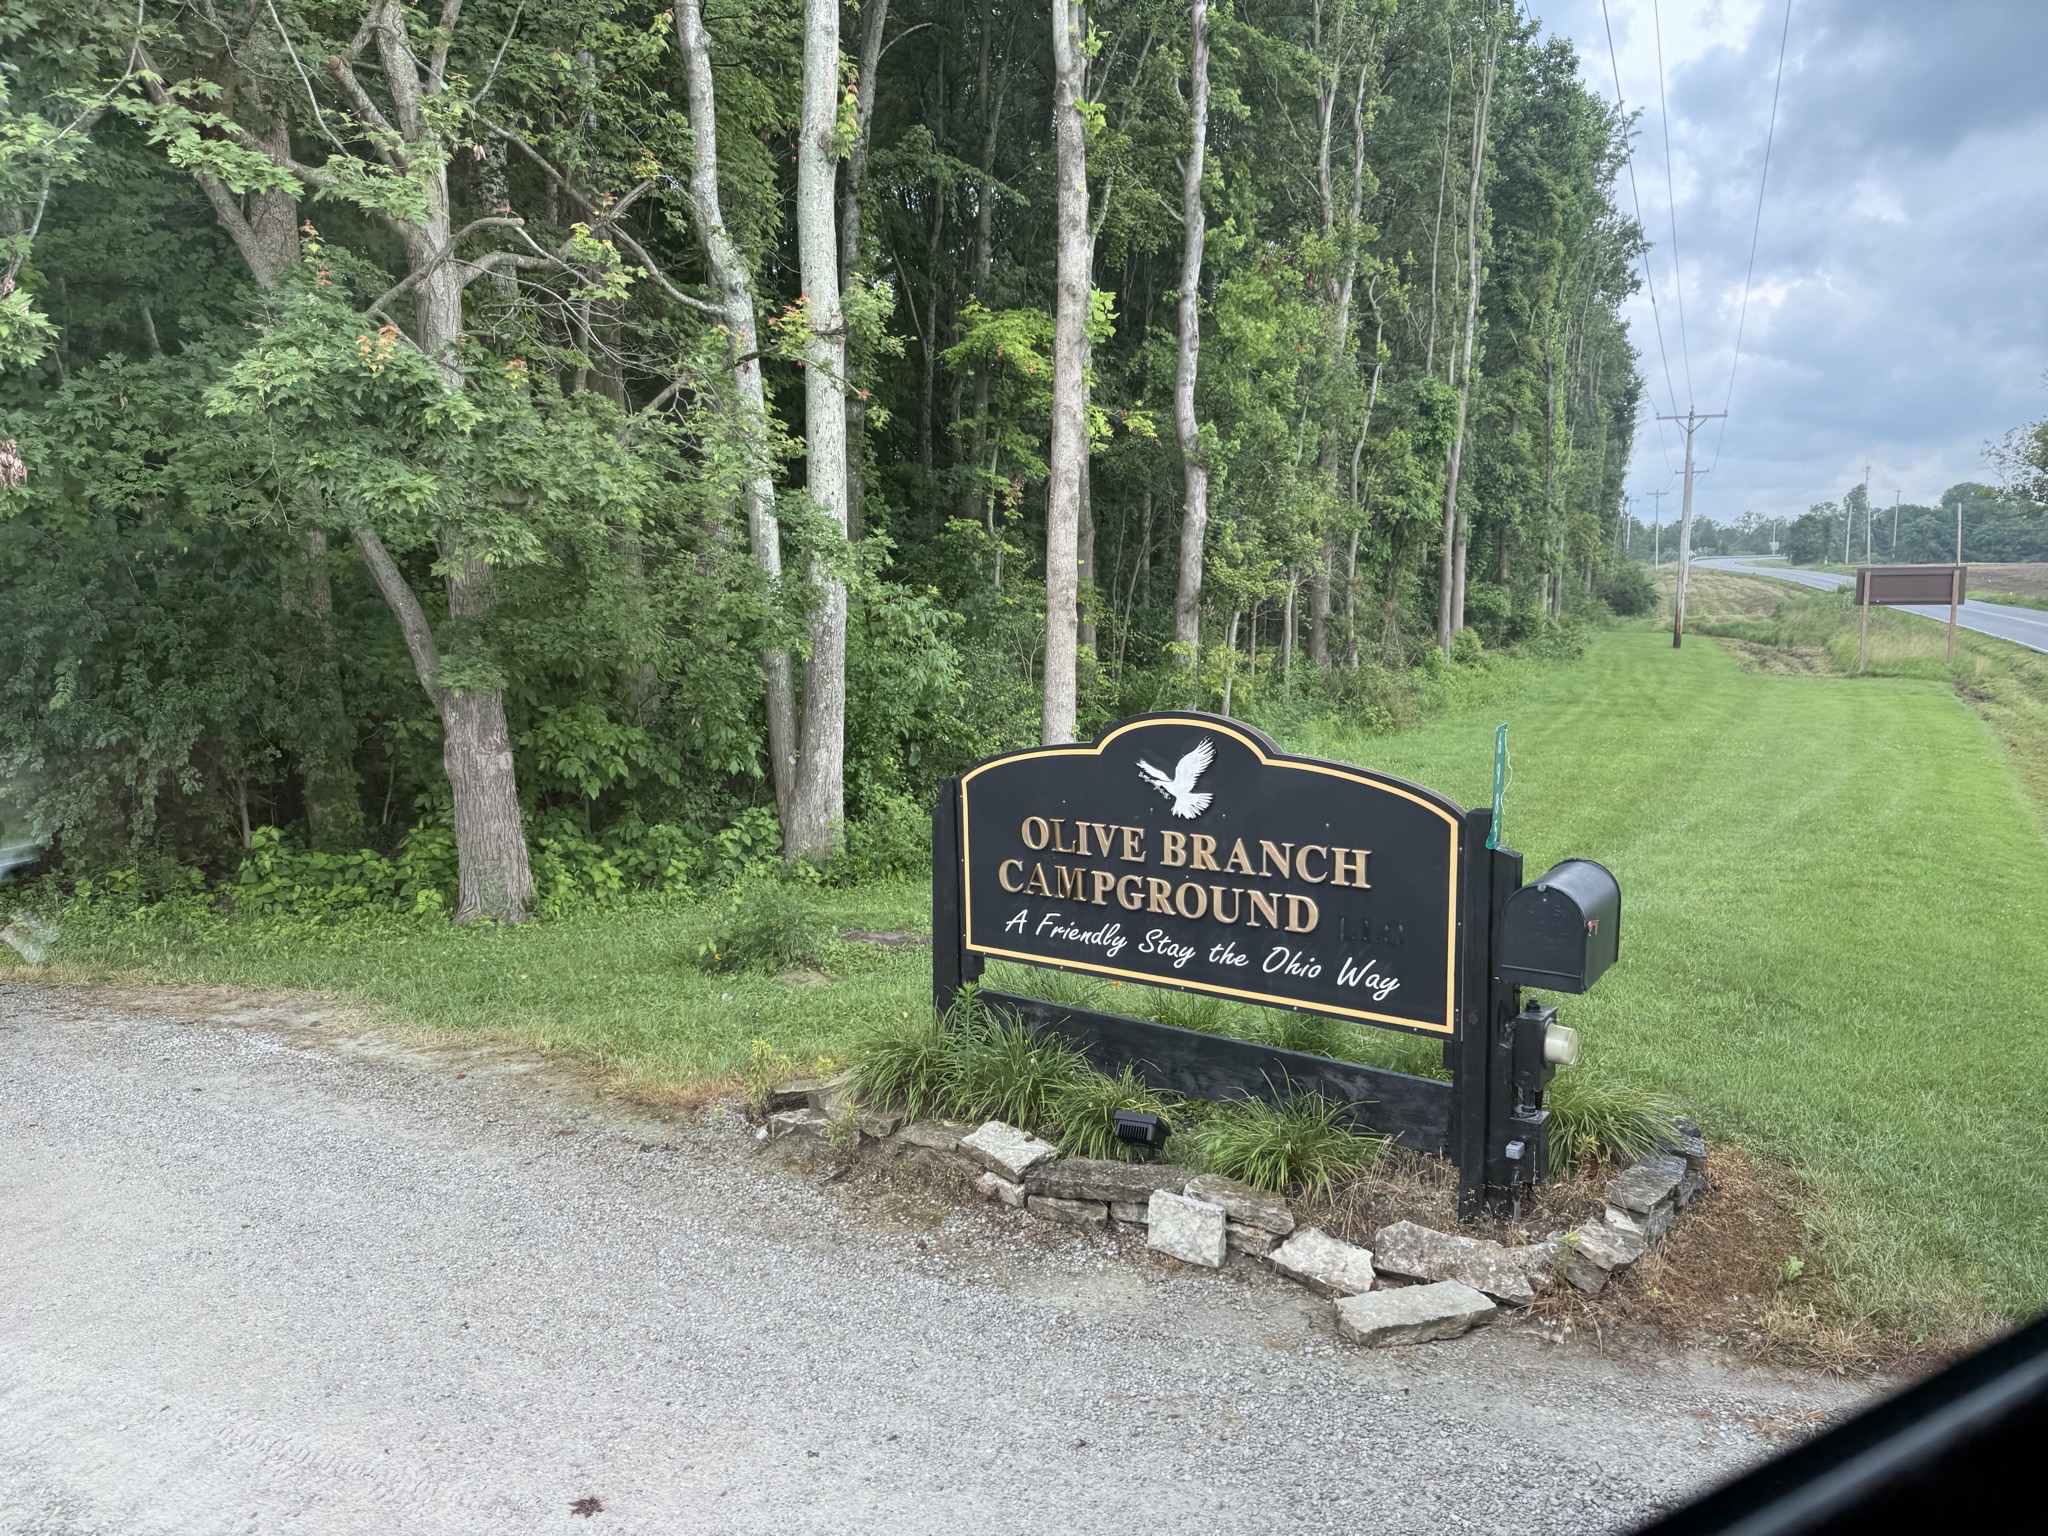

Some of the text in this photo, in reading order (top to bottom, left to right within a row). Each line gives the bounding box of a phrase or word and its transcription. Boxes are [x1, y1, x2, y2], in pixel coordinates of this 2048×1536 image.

[1021, 816, 1372, 889] OLIVE BRANCH
[998, 859, 1319, 933] CAMPGROUND
[1004, 908, 1400, 1001] A Friendly Stay the Ohio Way
